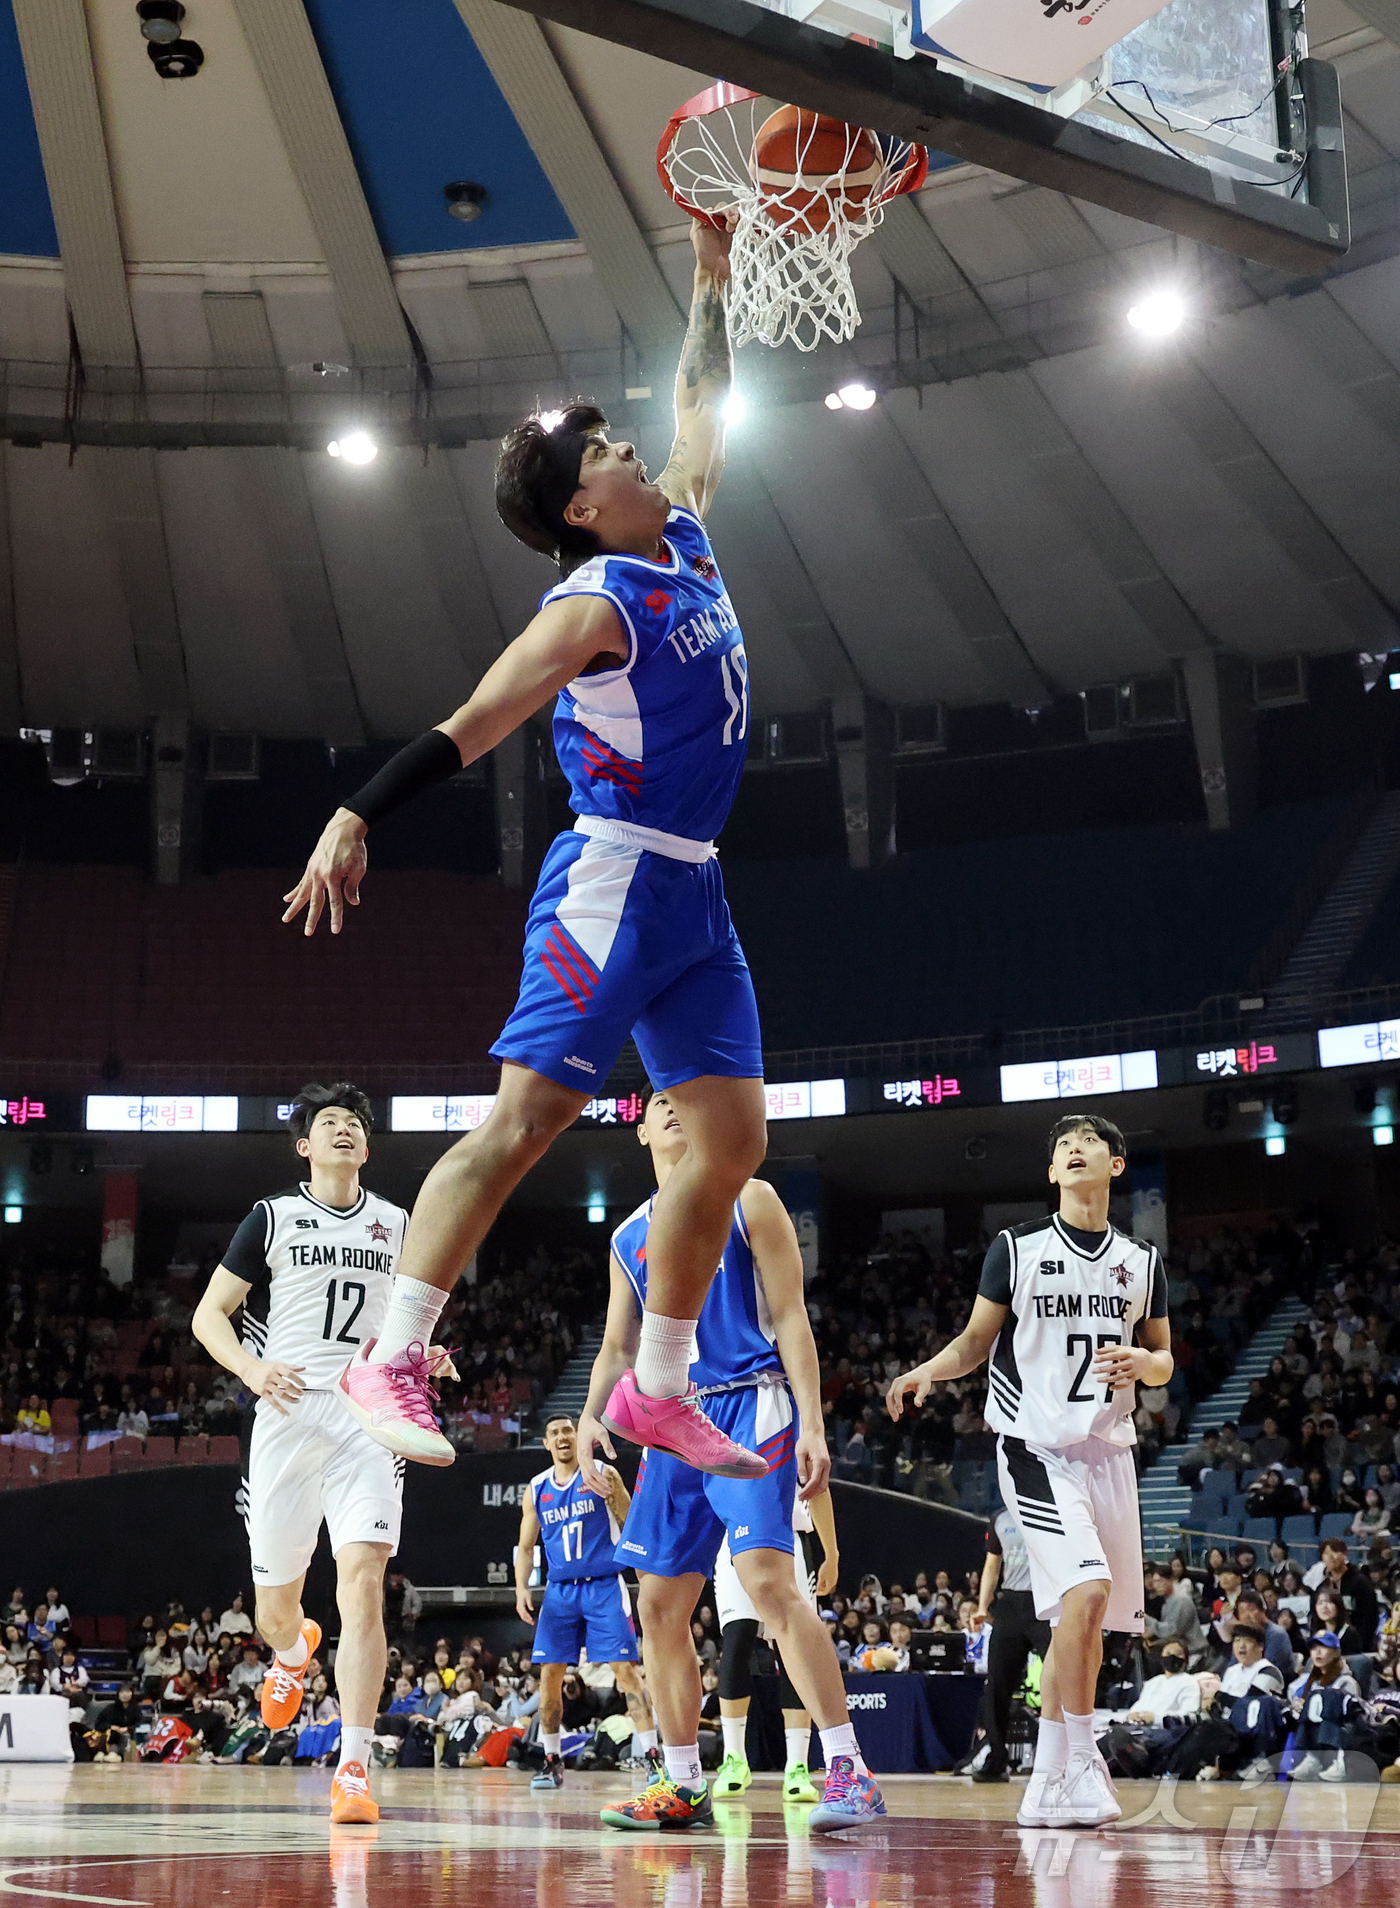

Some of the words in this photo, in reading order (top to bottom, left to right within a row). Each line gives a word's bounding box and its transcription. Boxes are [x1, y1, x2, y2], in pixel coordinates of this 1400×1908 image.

[645, 588, 673, 614] SI
[667, 608, 722, 664] TEAM
[1196, 1041, 1278, 1076] 티켓링크
[883, 1075, 961, 1106] 티켓링크
[1043, 1062, 1114, 1091] 티켓링크
[127, 1100, 195, 1126] 티켓링크
[580, 1093, 643, 1123] 티켓링
[295, 1219, 319, 1229] SI
[289, 1245, 336, 1266] TEAM
[341, 1247, 393, 1275] ROOKIE
[1040, 1260, 1065, 1275] SI
[322, 1278, 366, 1345] 12
[1033, 1294, 1082, 1318] TEAM
[542, 1506, 569, 1525] TEAM
[571, 1499, 595, 1517] ASIA
[562, 1520, 583, 1562] 17
[846, 1692, 887, 1710] SPORTS
